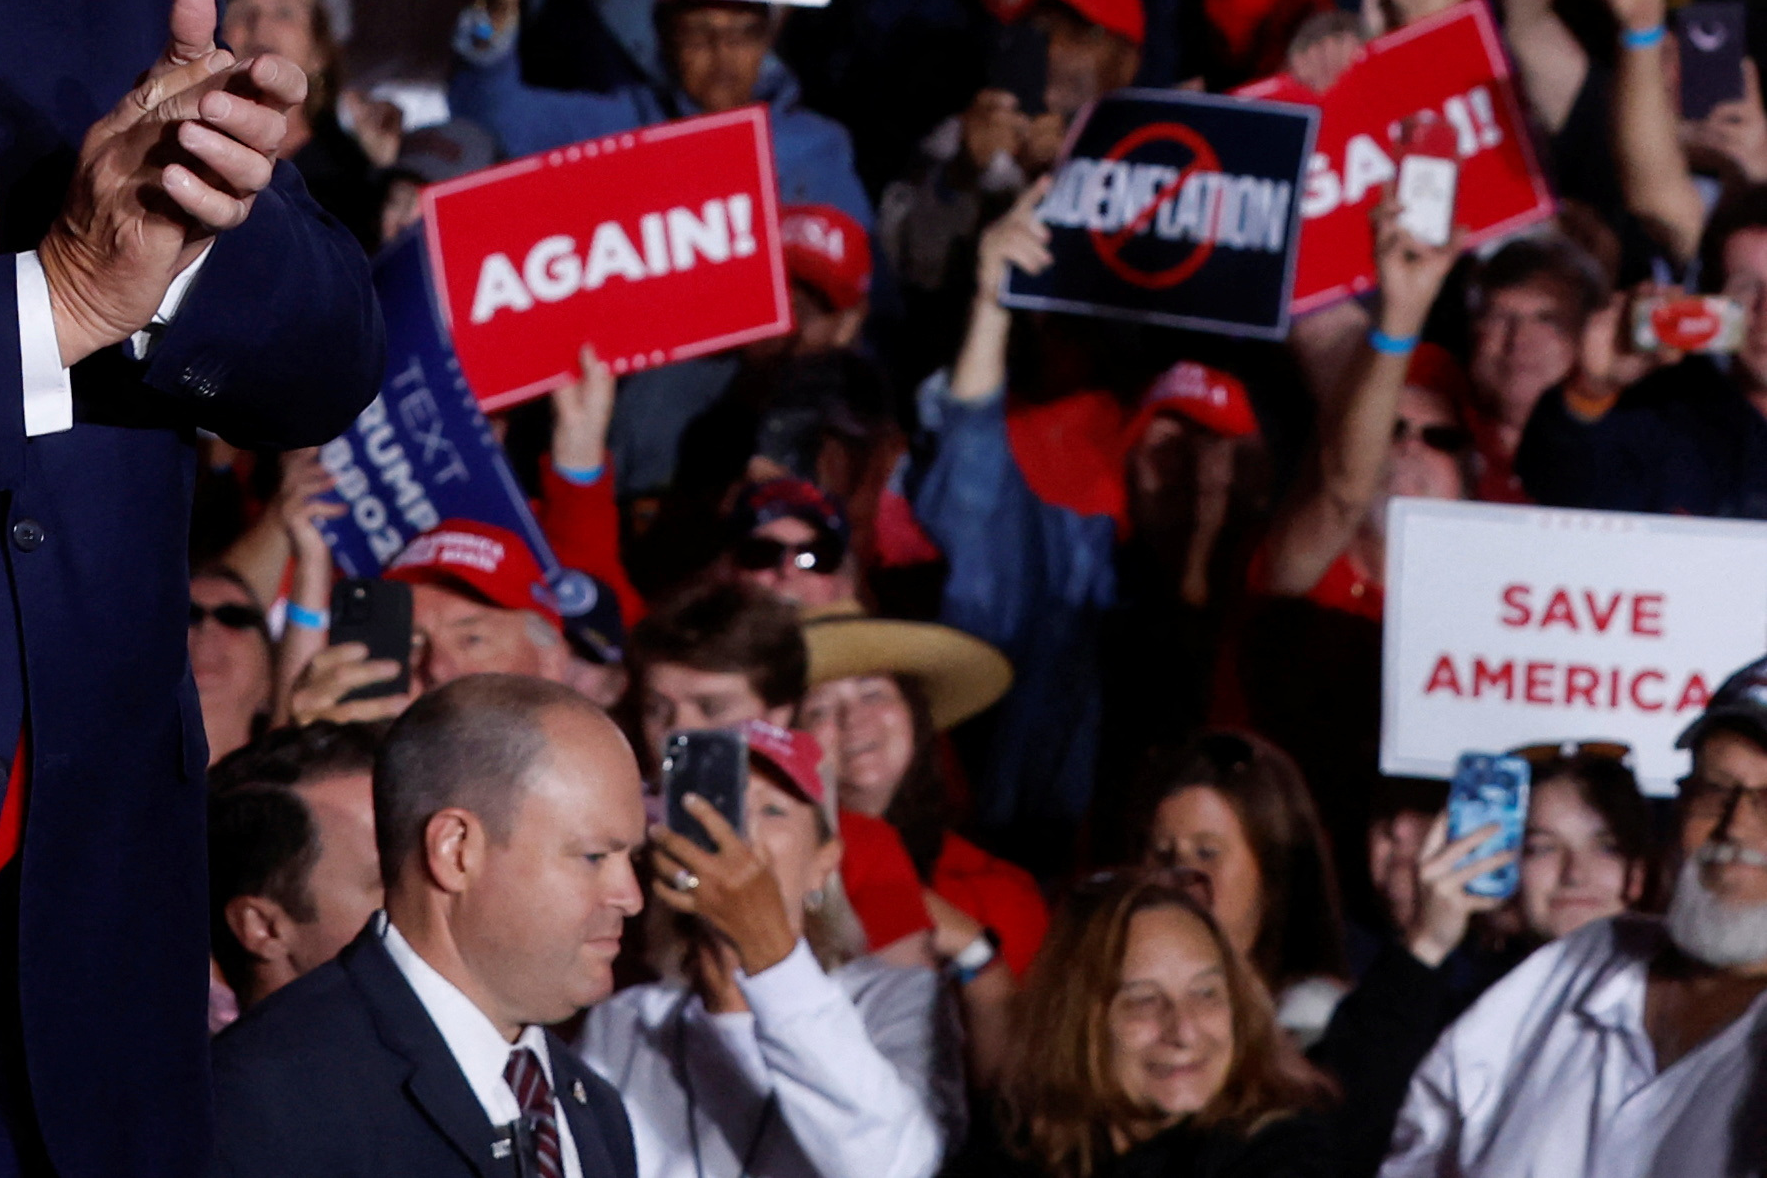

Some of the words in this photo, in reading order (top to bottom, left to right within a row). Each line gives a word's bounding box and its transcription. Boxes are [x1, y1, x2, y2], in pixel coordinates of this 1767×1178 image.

[470, 192, 757, 325] AGAIN!
[356, 391, 441, 532] RUMP
[391, 355, 471, 485] TEXT
[1499, 582, 1666, 639] SAVE
[1423, 651, 1714, 715] AMERICA
